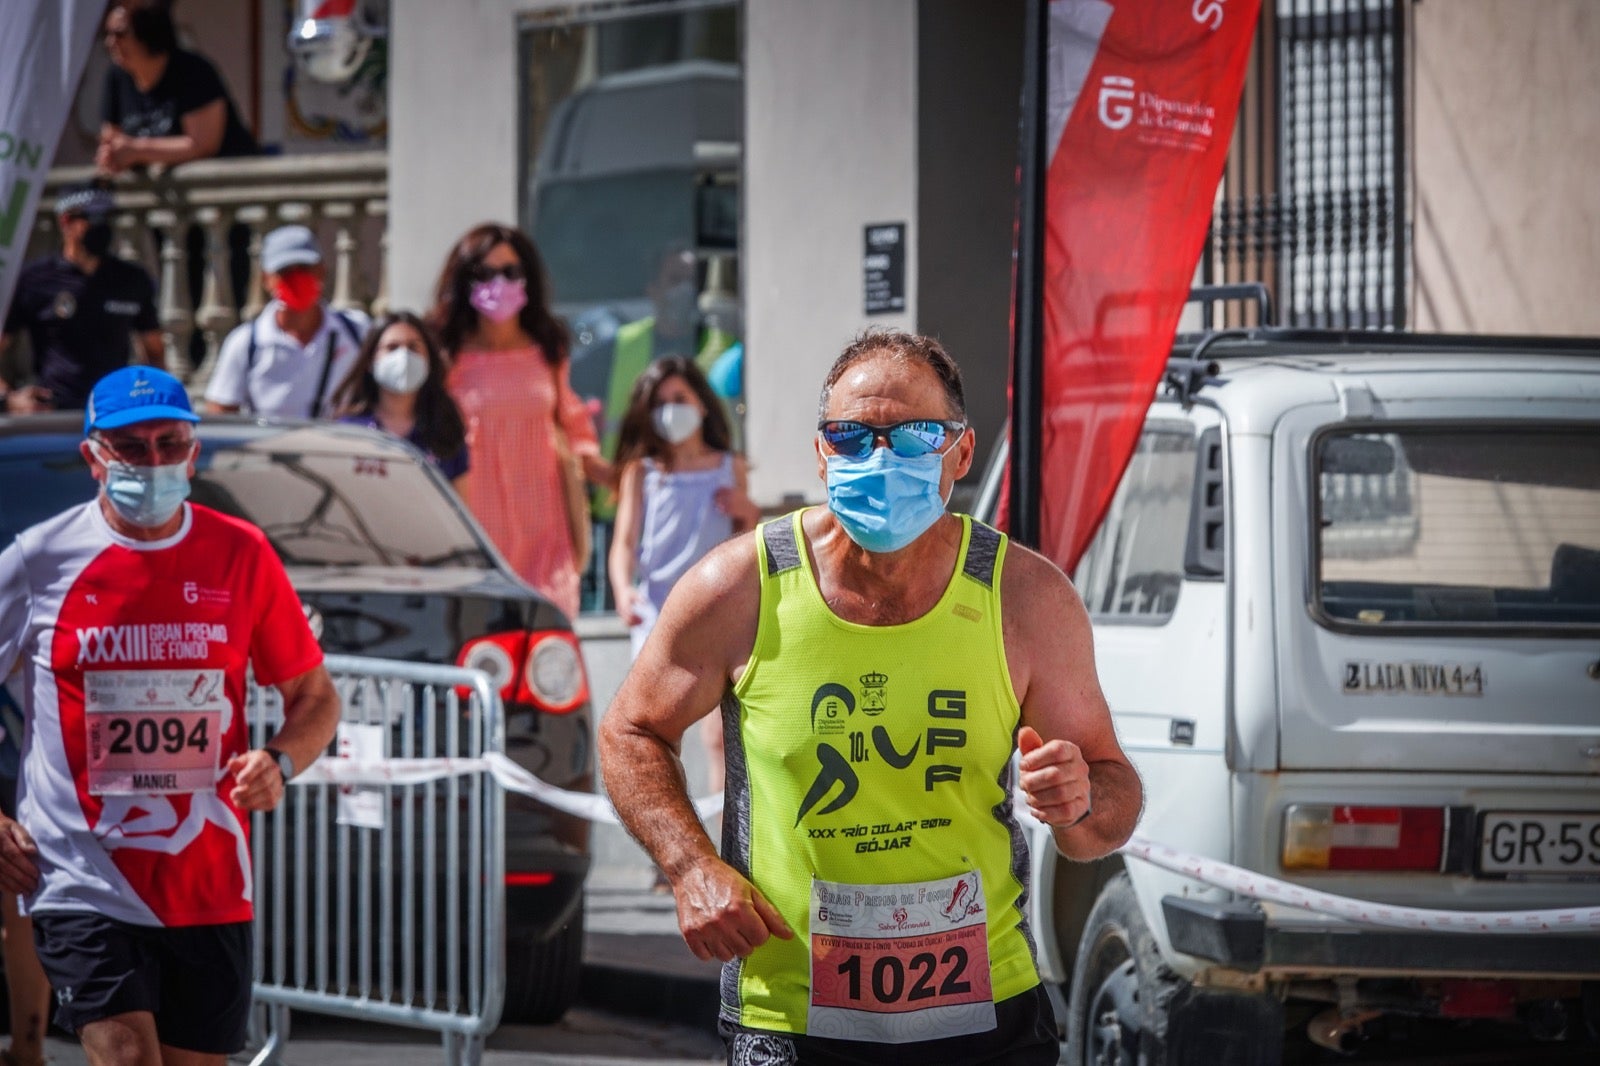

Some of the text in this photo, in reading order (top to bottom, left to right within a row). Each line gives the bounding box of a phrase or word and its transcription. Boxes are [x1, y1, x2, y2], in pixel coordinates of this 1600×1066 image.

[149, 622, 228, 643] GRAN PREMIO
[76, 625, 148, 664] XXXIII
[150, 641, 209, 660] DE FONDO
[1364, 662, 1405, 690] LADA
[1410, 662, 1448, 690] NIVA
[108, 718, 209, 755] 2094
[132, 773, 178, 789] MANUEL
[808, 828, 836, 838] XXX
[920, 817, 952, 829] 2018
[855, 836, 912, 853] GÓJAR
[838, 945, 971, 1004] 1022
